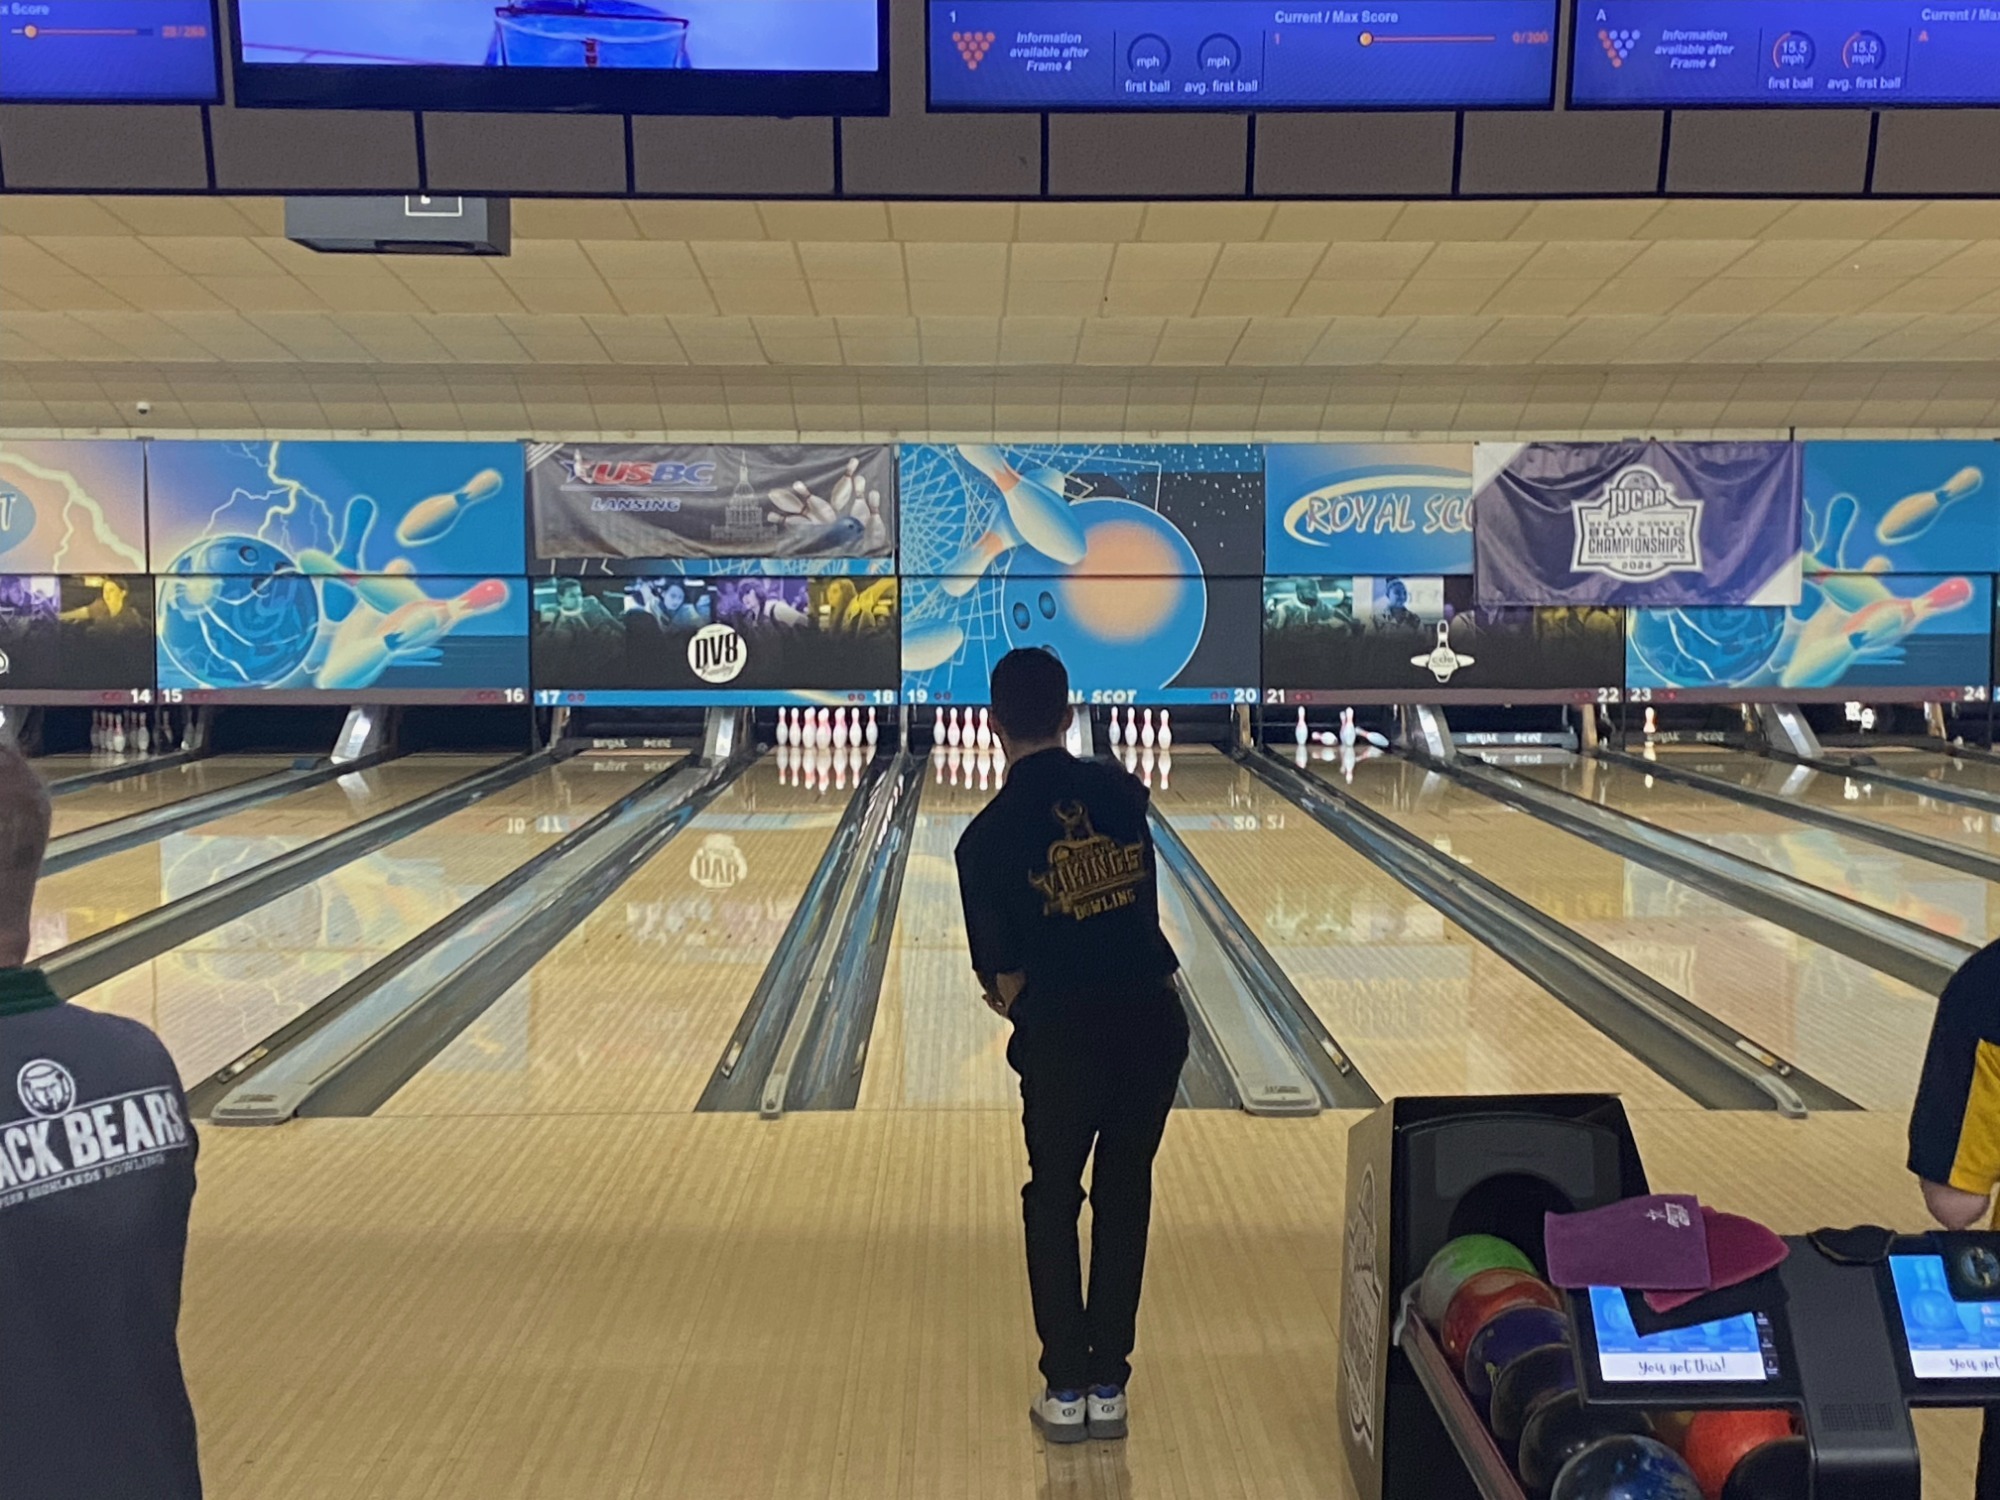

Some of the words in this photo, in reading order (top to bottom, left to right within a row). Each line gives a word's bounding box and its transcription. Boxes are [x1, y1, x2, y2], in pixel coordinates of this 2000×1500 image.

[12, 3, 49, 15] Score
[1596, 9, 1607, 21] A
[1922, 8, 1969, 21] Current
[950, 11, 957, 23] 1
[1275, 11, 1322, 24] Current
[1332, 12, 1358, 24] Max
[1362, 11, 1398, 24] Score
[1017, 32, 1082, 44] Information
[1662, 30, 1728, 41] Information
[1010, 46, 1060, 58] available
[1062, 46, 1089, 58] after
[1654, 44, 1705, 55] available
[1707, 44, 1734, 55] after
[1782, 41, 1807, 53] 15.5
[1853, 41, 1877, 53] 15.5
[1026, 60, 1062, 72] Frame
[1137, 55, 1160, 69] mph
[1207, 55, 1230, 69] mph
[1670, 58, 1707, 69] Frame
[1782, 54, 1804, 66] mph
[1852, 54, 1875, 66] mph
[1125, 80, 1147, 93] first
[1150, 80, 1171, 93] ball
[1185, 82, 1209, 95] avg.
[1212, 80, 1235, 92] first
[1237, 80, 1259, 92] ball
[1768, 77, 1790, 89] first
[1792, 77, 1814, 89] ball
[1828, 78, 1853, 91] avg.
[1856, 77, 1878, 89] first
[1880, 77, 1901, 89] ball
[592, 461, 717, 486] USBC
[591, 498, 681, 513] LANSING
[1306, 494, 1416, 535] ROYAL
[1422, 494, 1473, 535] SC
[1589, 527, 1686, 537] BOWLING
[1588, 537, 1686, 554] CHAMPIONSHIPS
[1622, 562, 1652, 570] 2024
[696, 632, 738, 670] DV8
[131, 688, 152, 704] 14
[162, 688, 183, 703] 15
[504, 688, 525, 703] 16
[540, 690, 561, 704] 17
[873, 689, 894, 704] 18
[907, 689, 928, 704] 19
[1092, 689, 1137, 704] SCOT
[1234, 688, 1257, 703] 20
[1267, 688, 1285, 703] 21
[1597, 687, 1619, 703] 22
[1630, 687, 1652, 702] 23
[1964, 686, 1986, 701] 24
[1074, 889, 1136, 921] BOWLING
[64, 1092, 186, 1168] BEARS
[1670, 1359, 1692, 1376] got
[1695, 1356, 1726, 1374] this!
